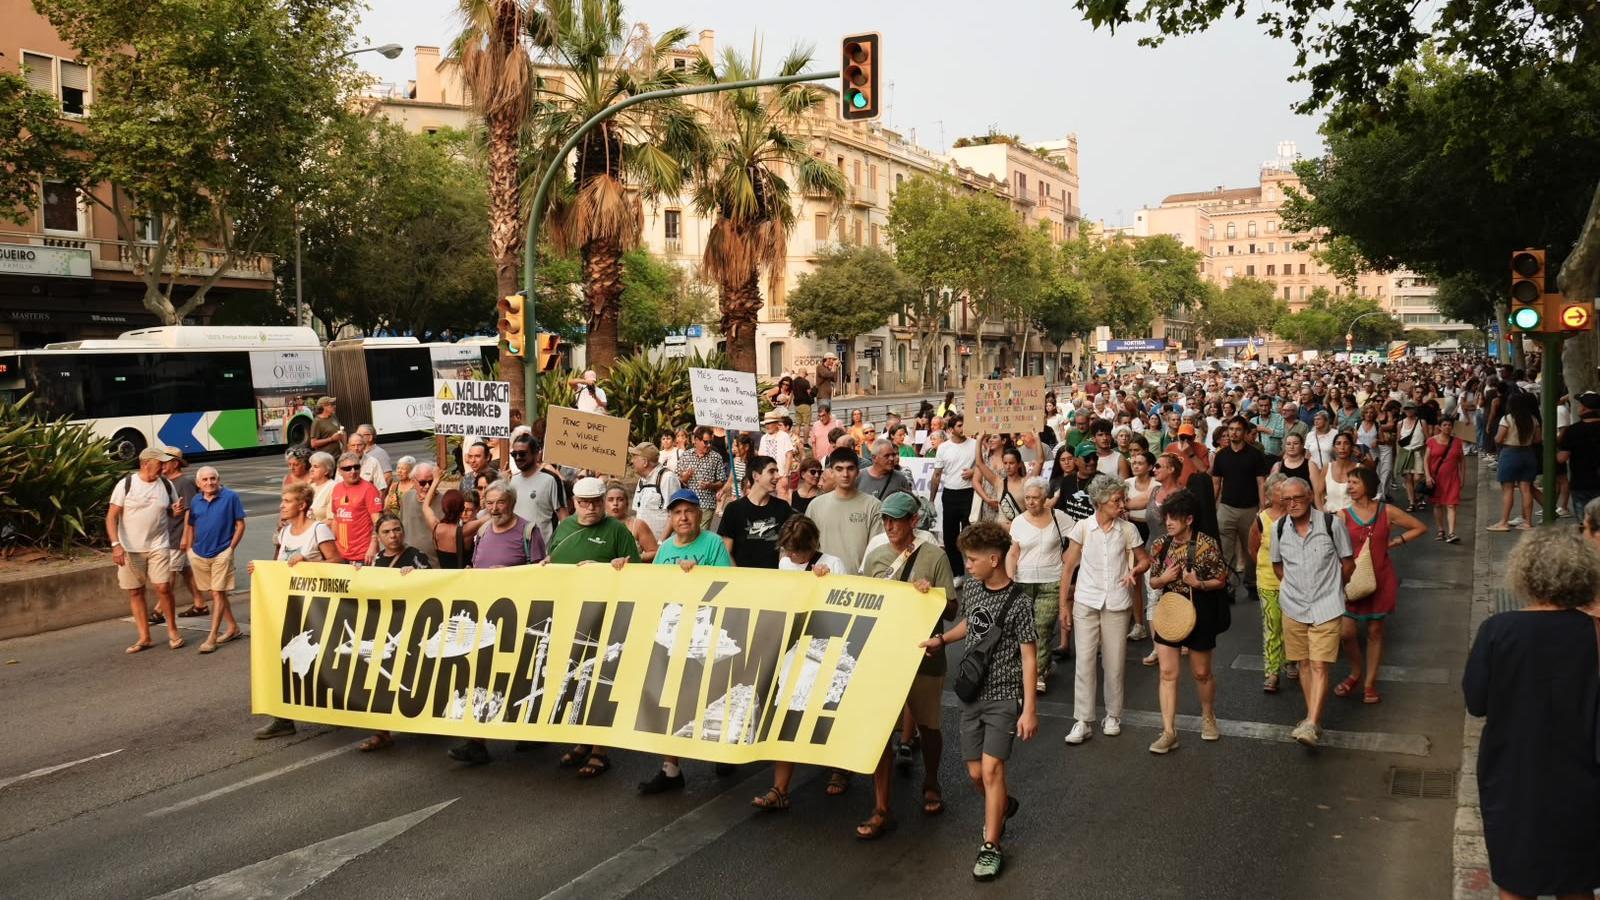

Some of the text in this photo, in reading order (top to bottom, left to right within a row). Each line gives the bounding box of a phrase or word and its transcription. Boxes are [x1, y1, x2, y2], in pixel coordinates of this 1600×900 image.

[11, 312, 50, 320] MASTERS
[456, 382, 510, 402] MALLORCA
[441, 402, 502, 419] OVERBOOKED
[466, 425, 474, 435] NO
[475, 425, 510, 437] MALLORCA
[562, 416, 608, 433] TENC DRET
[563, 429, 569, 437] A
[555, 439, 567, 447] ON
[570, 441, 588, 451] VAIG
[289, 576, 351, 593] MENYS TURISME
[825, 587, 885, 611] MÉS VIDA
[281, 581, 878, 746] MALLORCA AL LÍMIT!
